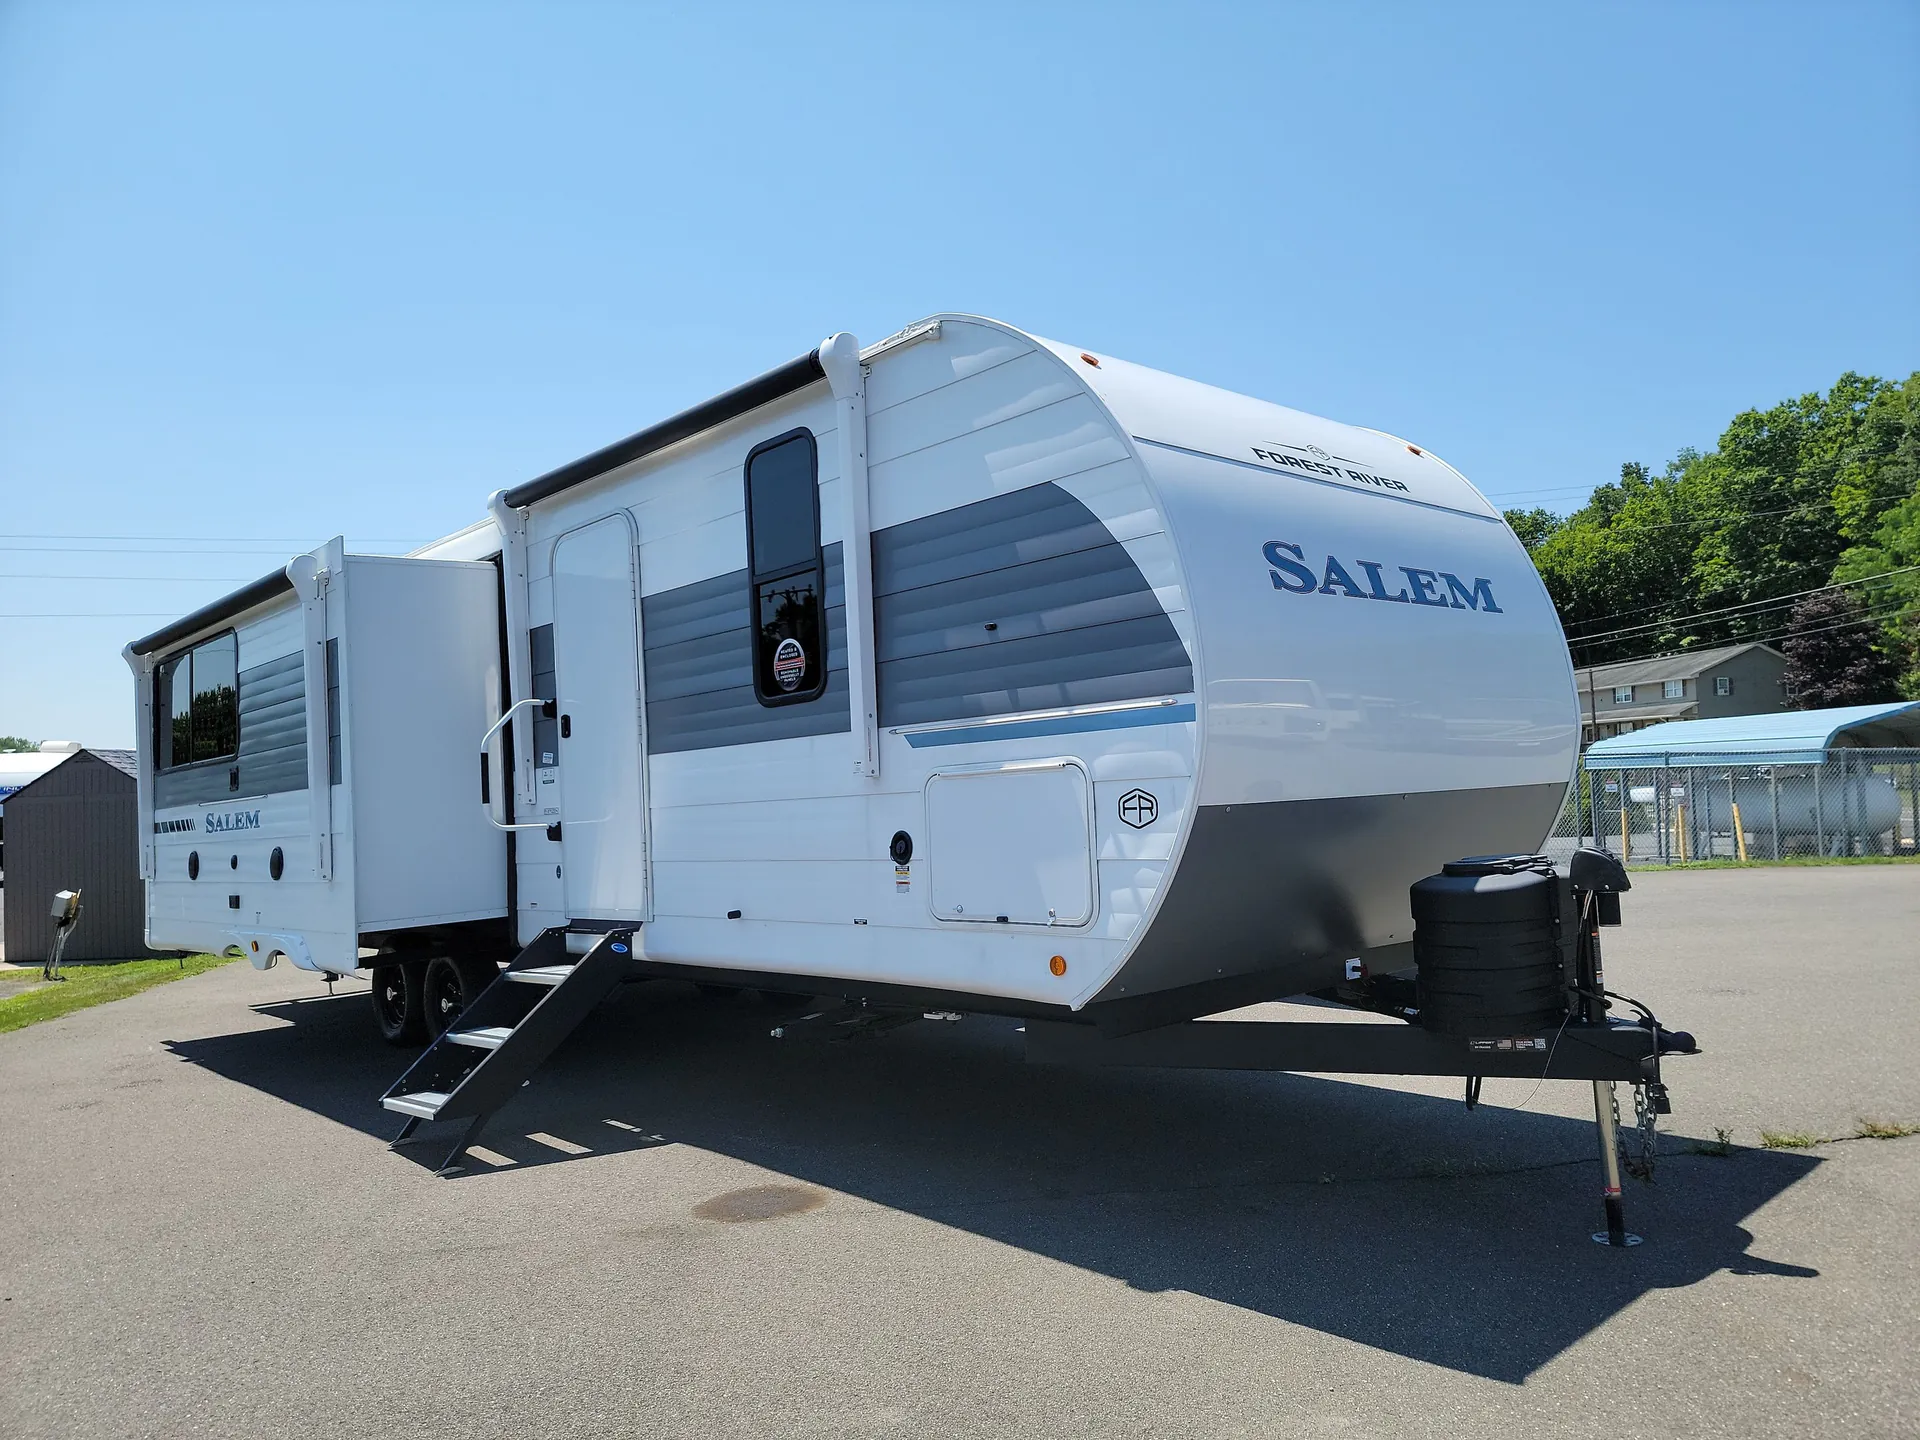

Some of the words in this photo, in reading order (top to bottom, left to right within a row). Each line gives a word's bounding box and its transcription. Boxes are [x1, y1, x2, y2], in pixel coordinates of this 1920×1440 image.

[1250, 447, 1343, 478] FOREST
[1345, 469, 1411, 493] RIVER
[1262, 540, 1504, 614] SALEM
[205, 810, 261, 833] SALEM
[1122, 793, 1154, 824] FR
